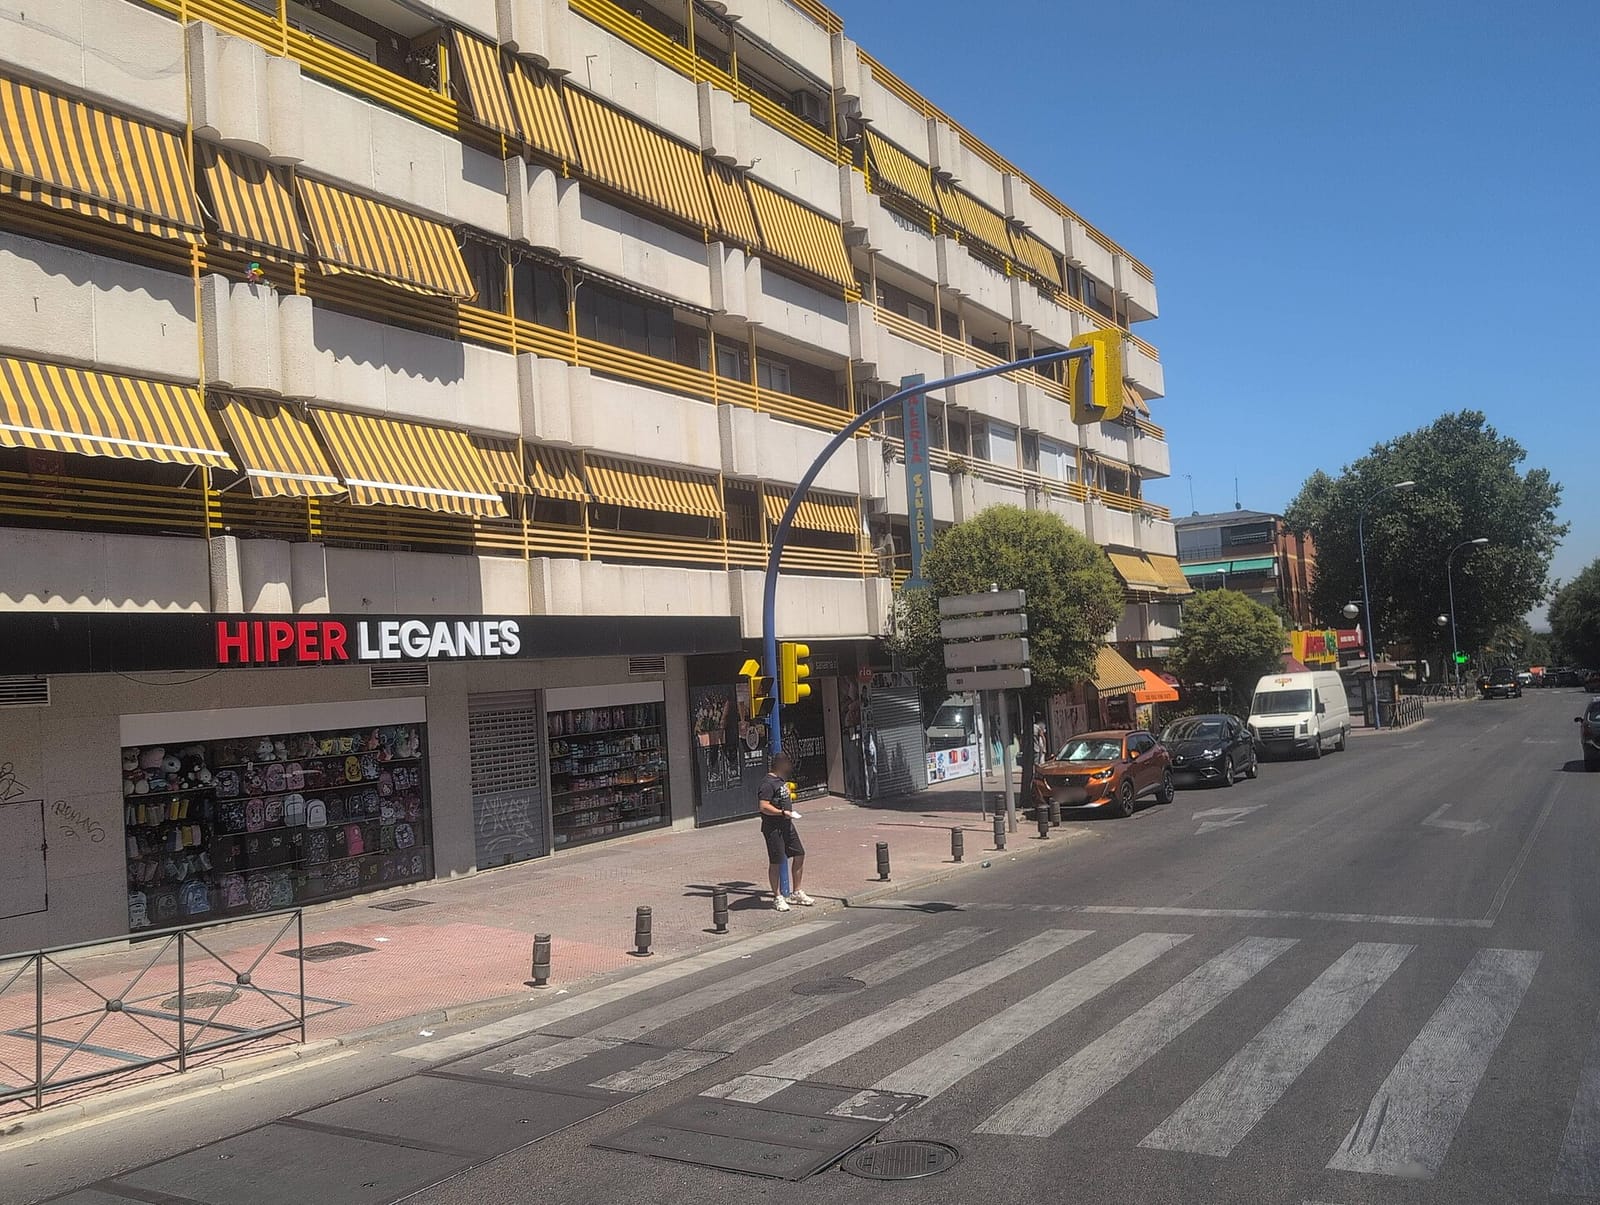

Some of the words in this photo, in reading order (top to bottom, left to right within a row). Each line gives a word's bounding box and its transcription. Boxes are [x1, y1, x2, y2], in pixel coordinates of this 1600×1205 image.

[912, 472, 927, 562] SANABRI
[216, 620, 350, 664] HIPER
[357, 619, 521, 660] LEGANES
